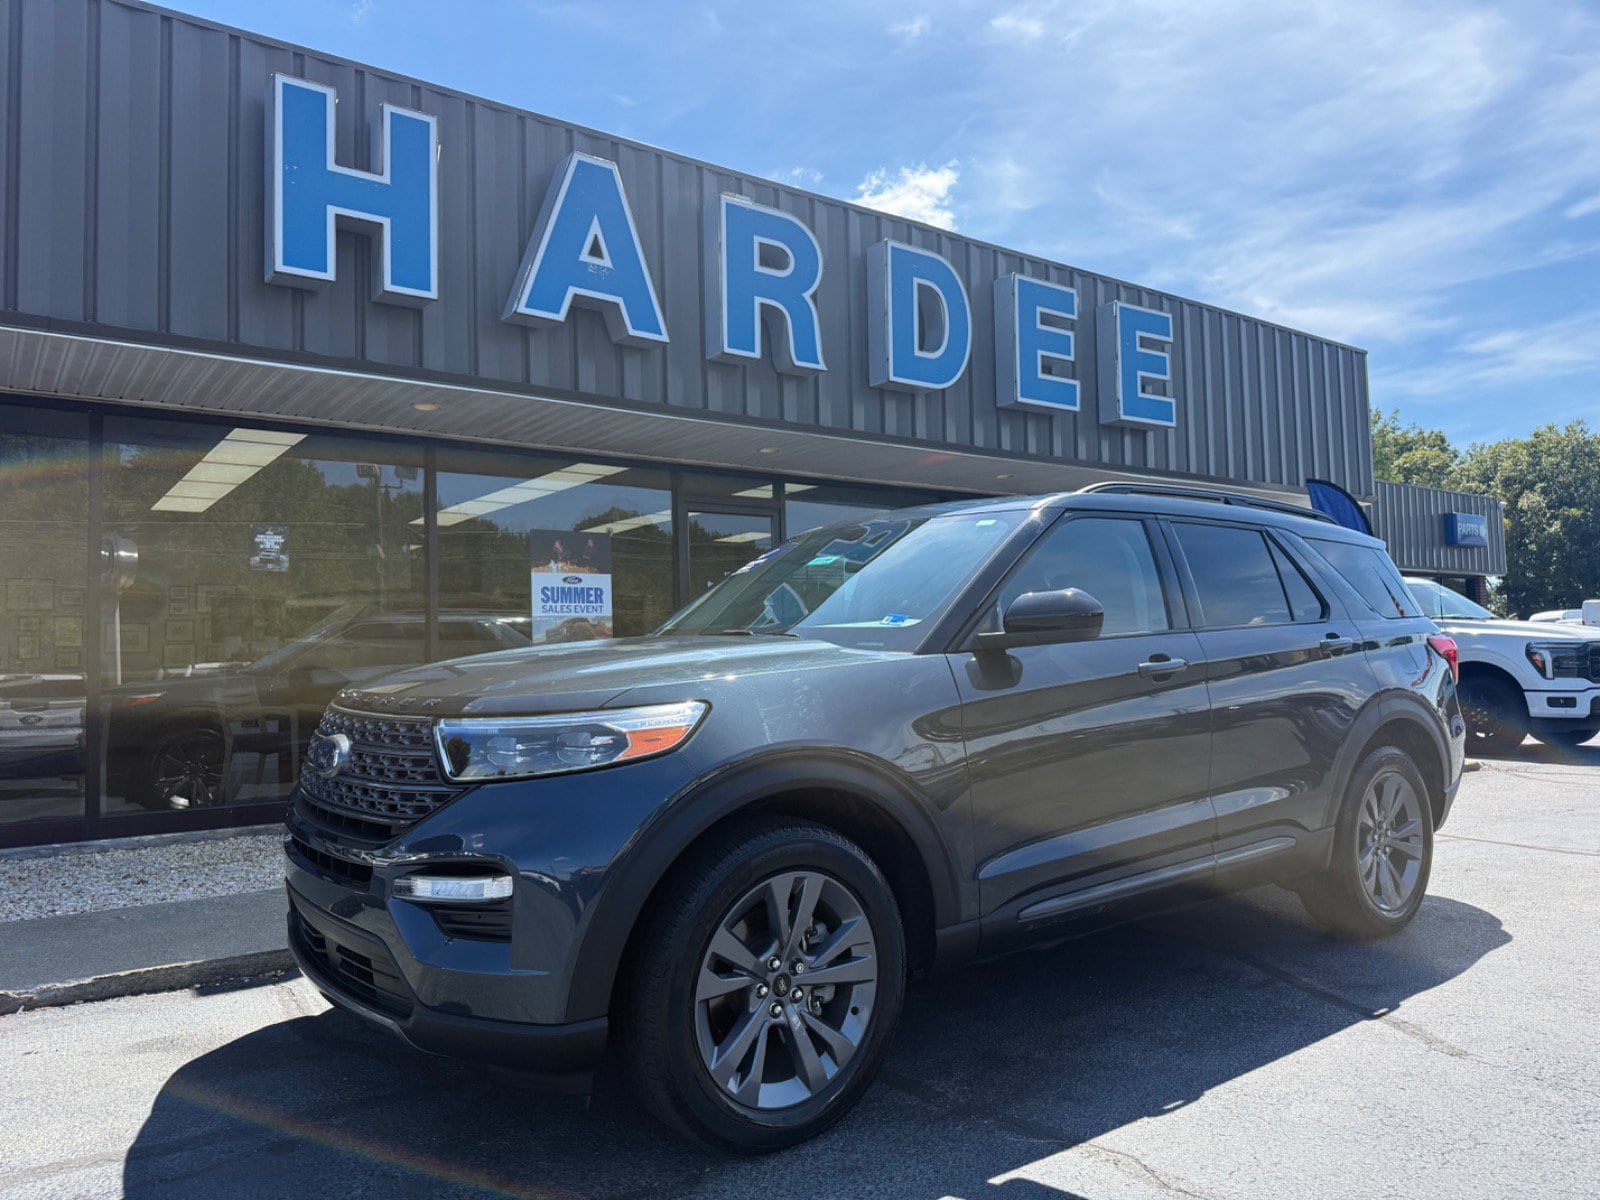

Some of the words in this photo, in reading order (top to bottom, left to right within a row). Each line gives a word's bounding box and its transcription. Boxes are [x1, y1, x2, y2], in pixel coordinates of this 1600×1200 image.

[267, 72, 1177, 428] HARDEE
[1457, 522, 1479, 536] PARTS
[541, 586, 604, 604] SUMMER
[541, 604, 571, 613] SALES
[574, 604, 603, 614] EVENT
